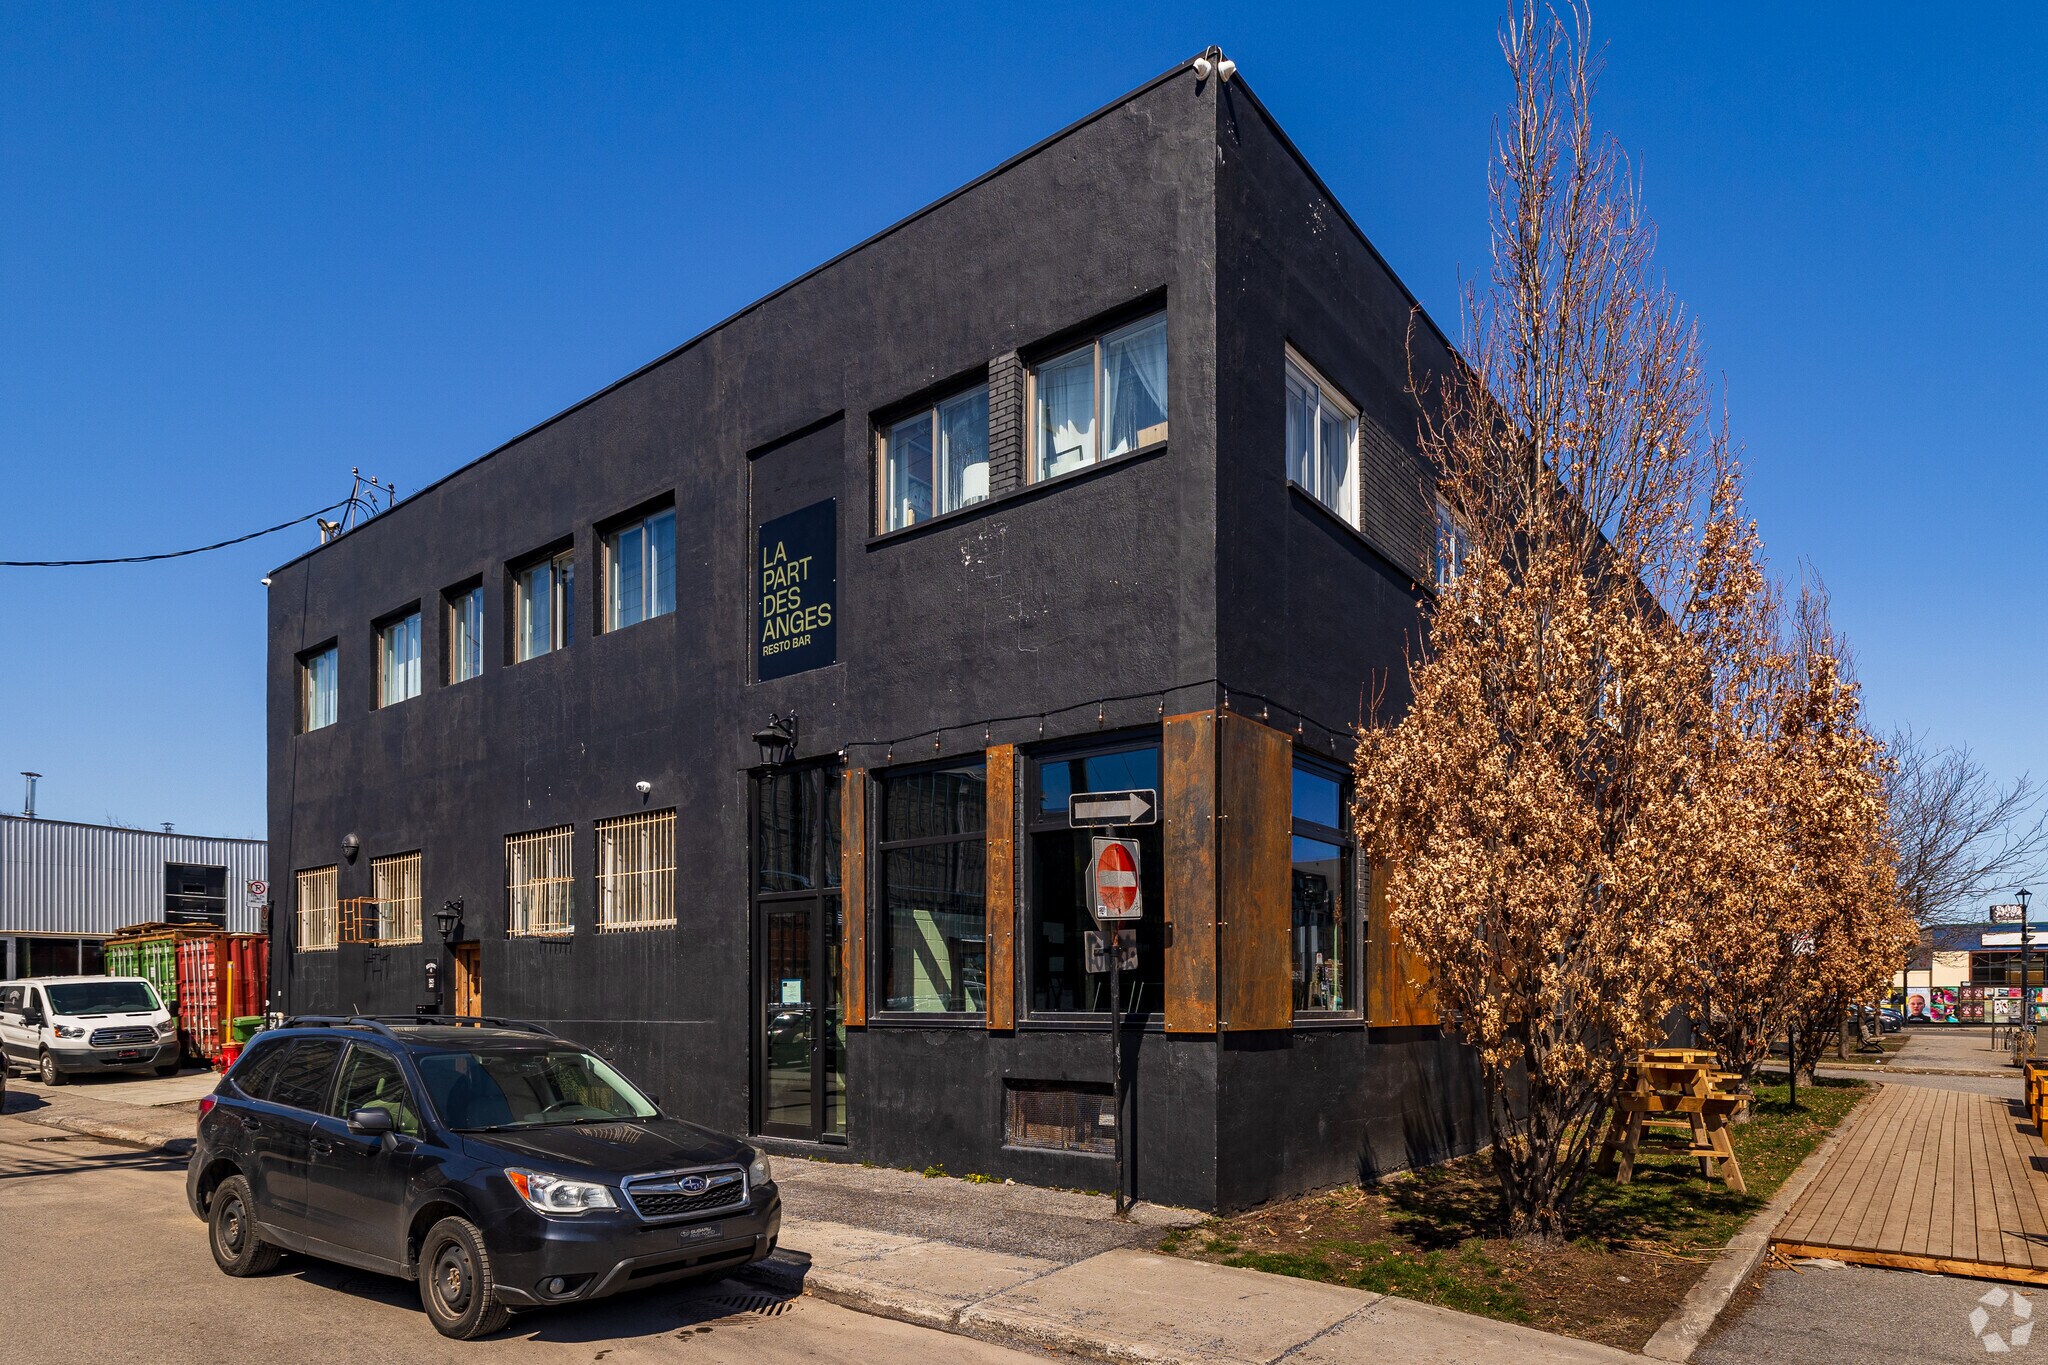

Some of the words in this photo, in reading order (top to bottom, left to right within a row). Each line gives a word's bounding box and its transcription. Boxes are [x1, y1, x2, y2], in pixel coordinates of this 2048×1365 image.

[763, 541, 787, 569] LA
[763, 556, 813, 593] PART
[763, 586, 801, 617] DES
[762, 603, 832, 643] ANGES
[762, 640, 790, 657] RESTO
[792, 634, 811, 649] BAR
